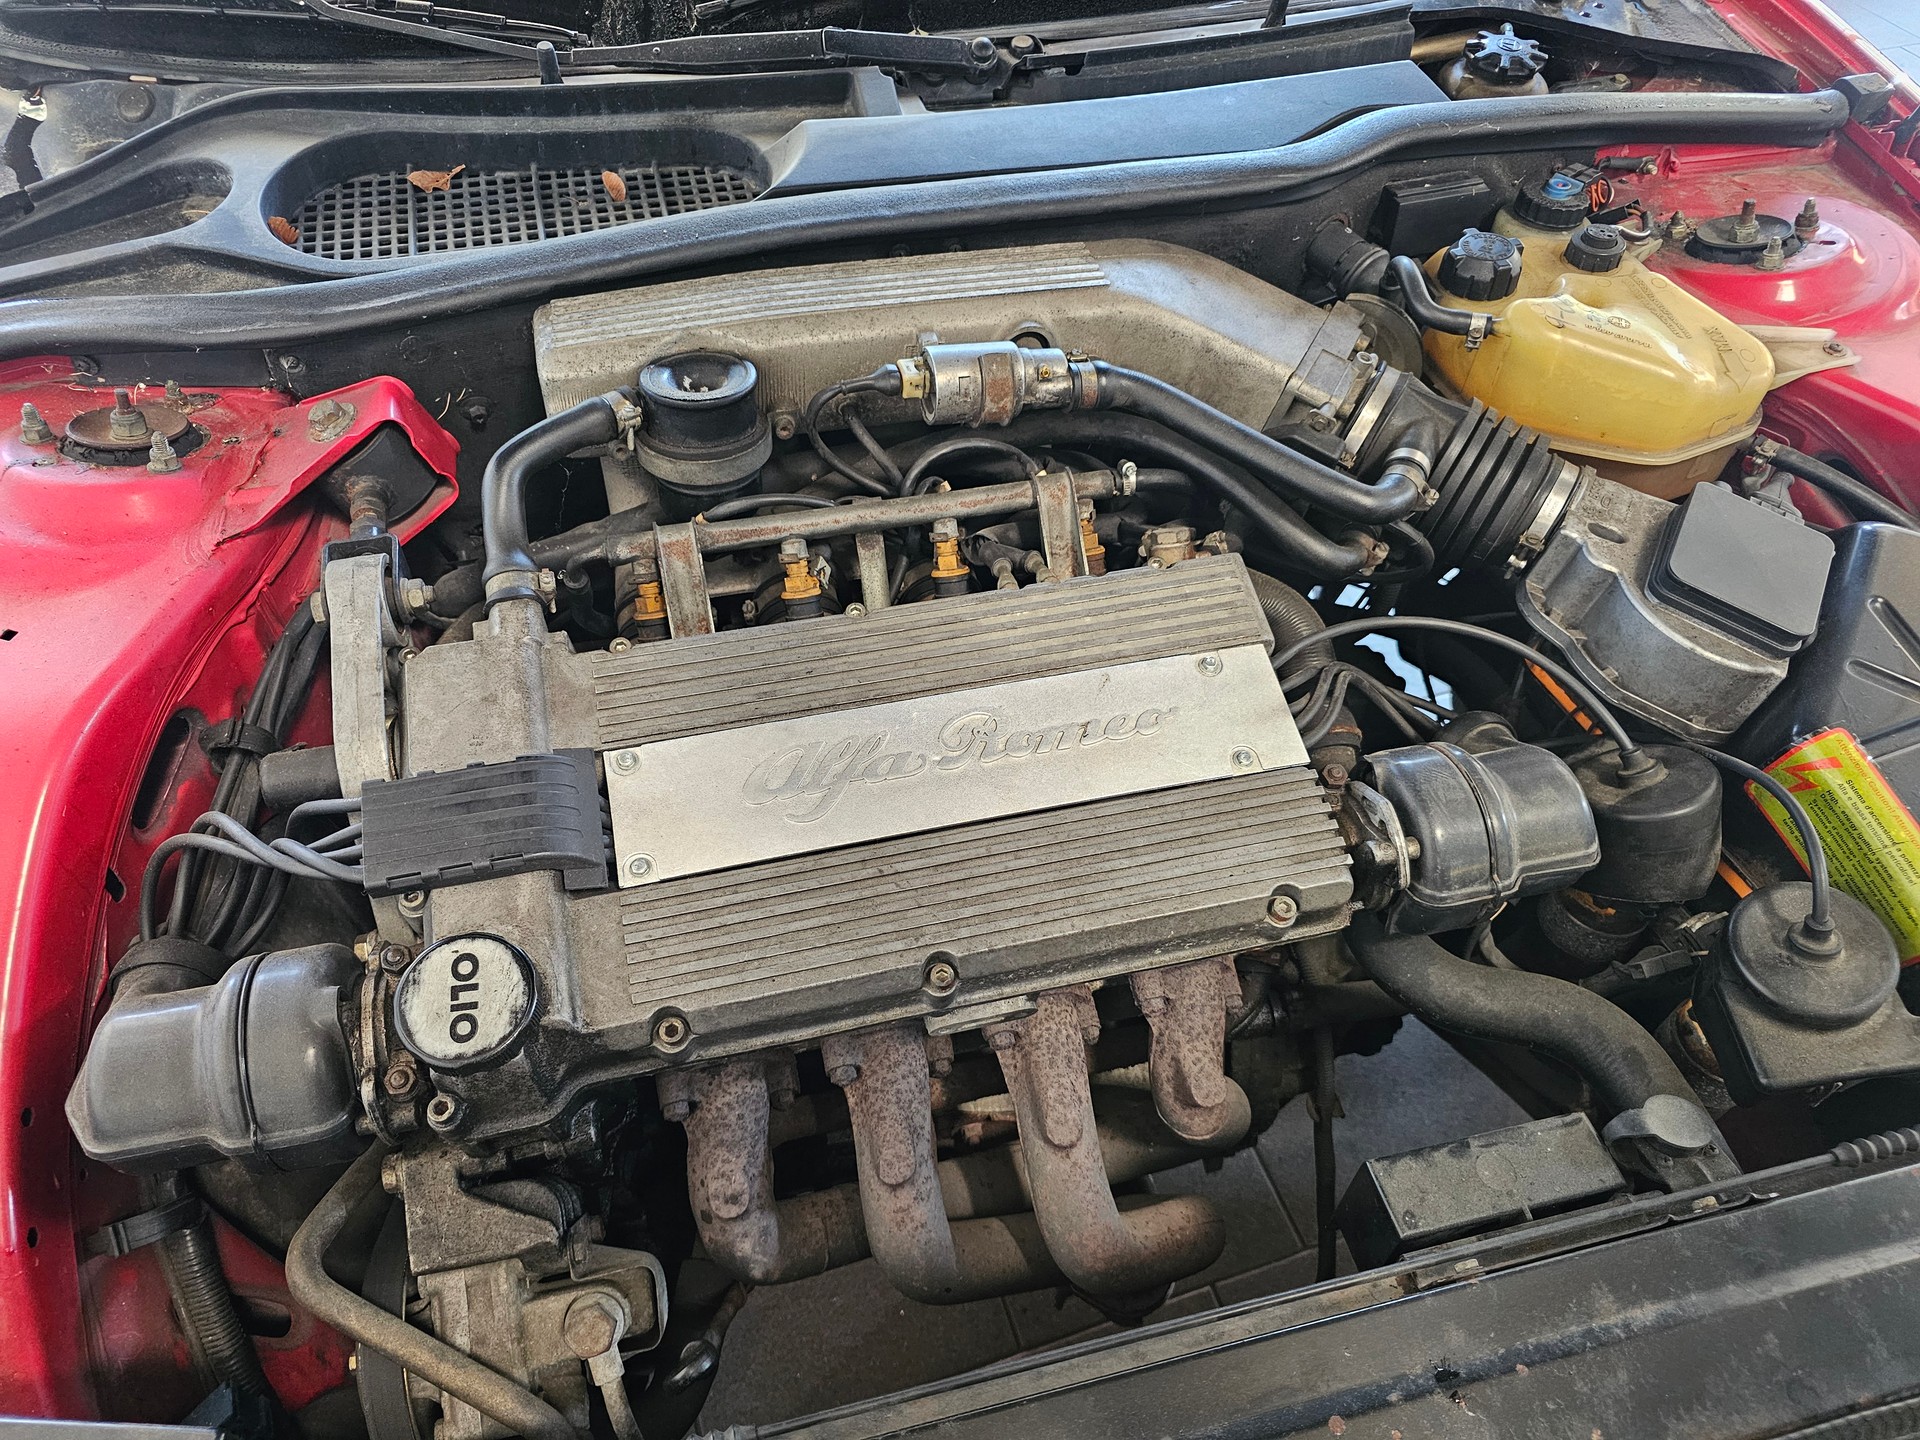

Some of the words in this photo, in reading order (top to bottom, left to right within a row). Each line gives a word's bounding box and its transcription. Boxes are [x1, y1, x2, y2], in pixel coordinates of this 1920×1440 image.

[742, 728, 926, 824] Alfa
[937, 703, 1178, 772] Romeo
[1836, 738, 1871, 781] Attenzione!
[1868, 780, 1895, 814] Caution!
[1846, 779, 1866, 805] Sistema
[1808, 802, 1829, 830] Tensions
[1827, 830, 1847, 855] primaire
[1826, 789, 1839, 806] High
[1841, 809, 1858, 832] energy
[1856, 832, 1877, 858] ignition
[1851, 802, 1867, 821] bassa
[1820, 793, 1846, 827] Dangerous
[1844, 827, 1864, 851] primary
[1863, 852, 1874, 865] and
[1873, 865, 1898, 898] secondary
[1833, 865, 1845, 878] und
[1856, 859, 1871, 878] haute
[449, 952, 480, 1044] OLIO
